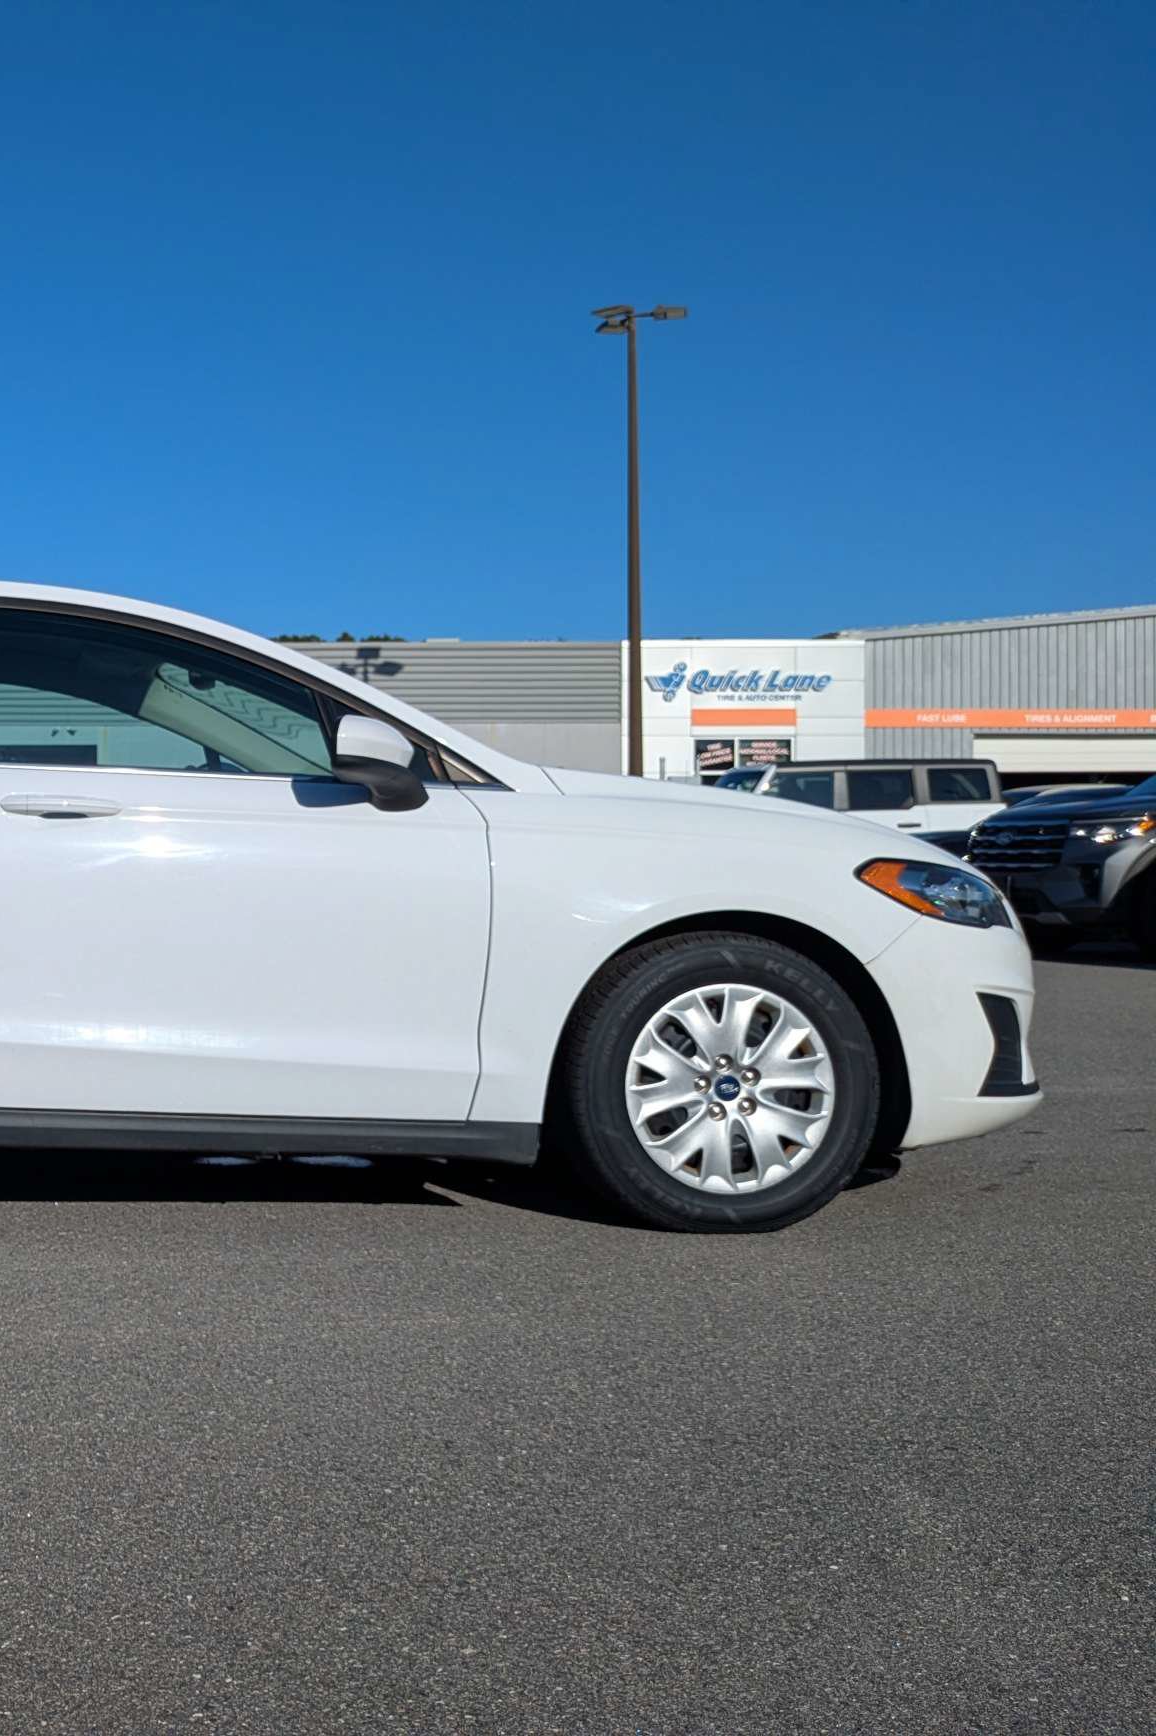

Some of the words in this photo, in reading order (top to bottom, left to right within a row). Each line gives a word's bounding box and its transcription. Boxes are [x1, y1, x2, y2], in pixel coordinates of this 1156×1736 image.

[687, 669, 764, 694] Quick
[762, 669, 832, 692] Lane
[717, 694, 735, 702] TIRE
[745, 694, 767, 702] AUTO
[768, 694, 802, 702] CENTER
[916, 713, 940, 722] FAST
[942, 713, 966, 723] LUBE
[1025, 714, 1052, 723] TIRES
[1062, 714, 1117, 723] ALIGNMENT
[765, 960, 840, 1011] KELLY
